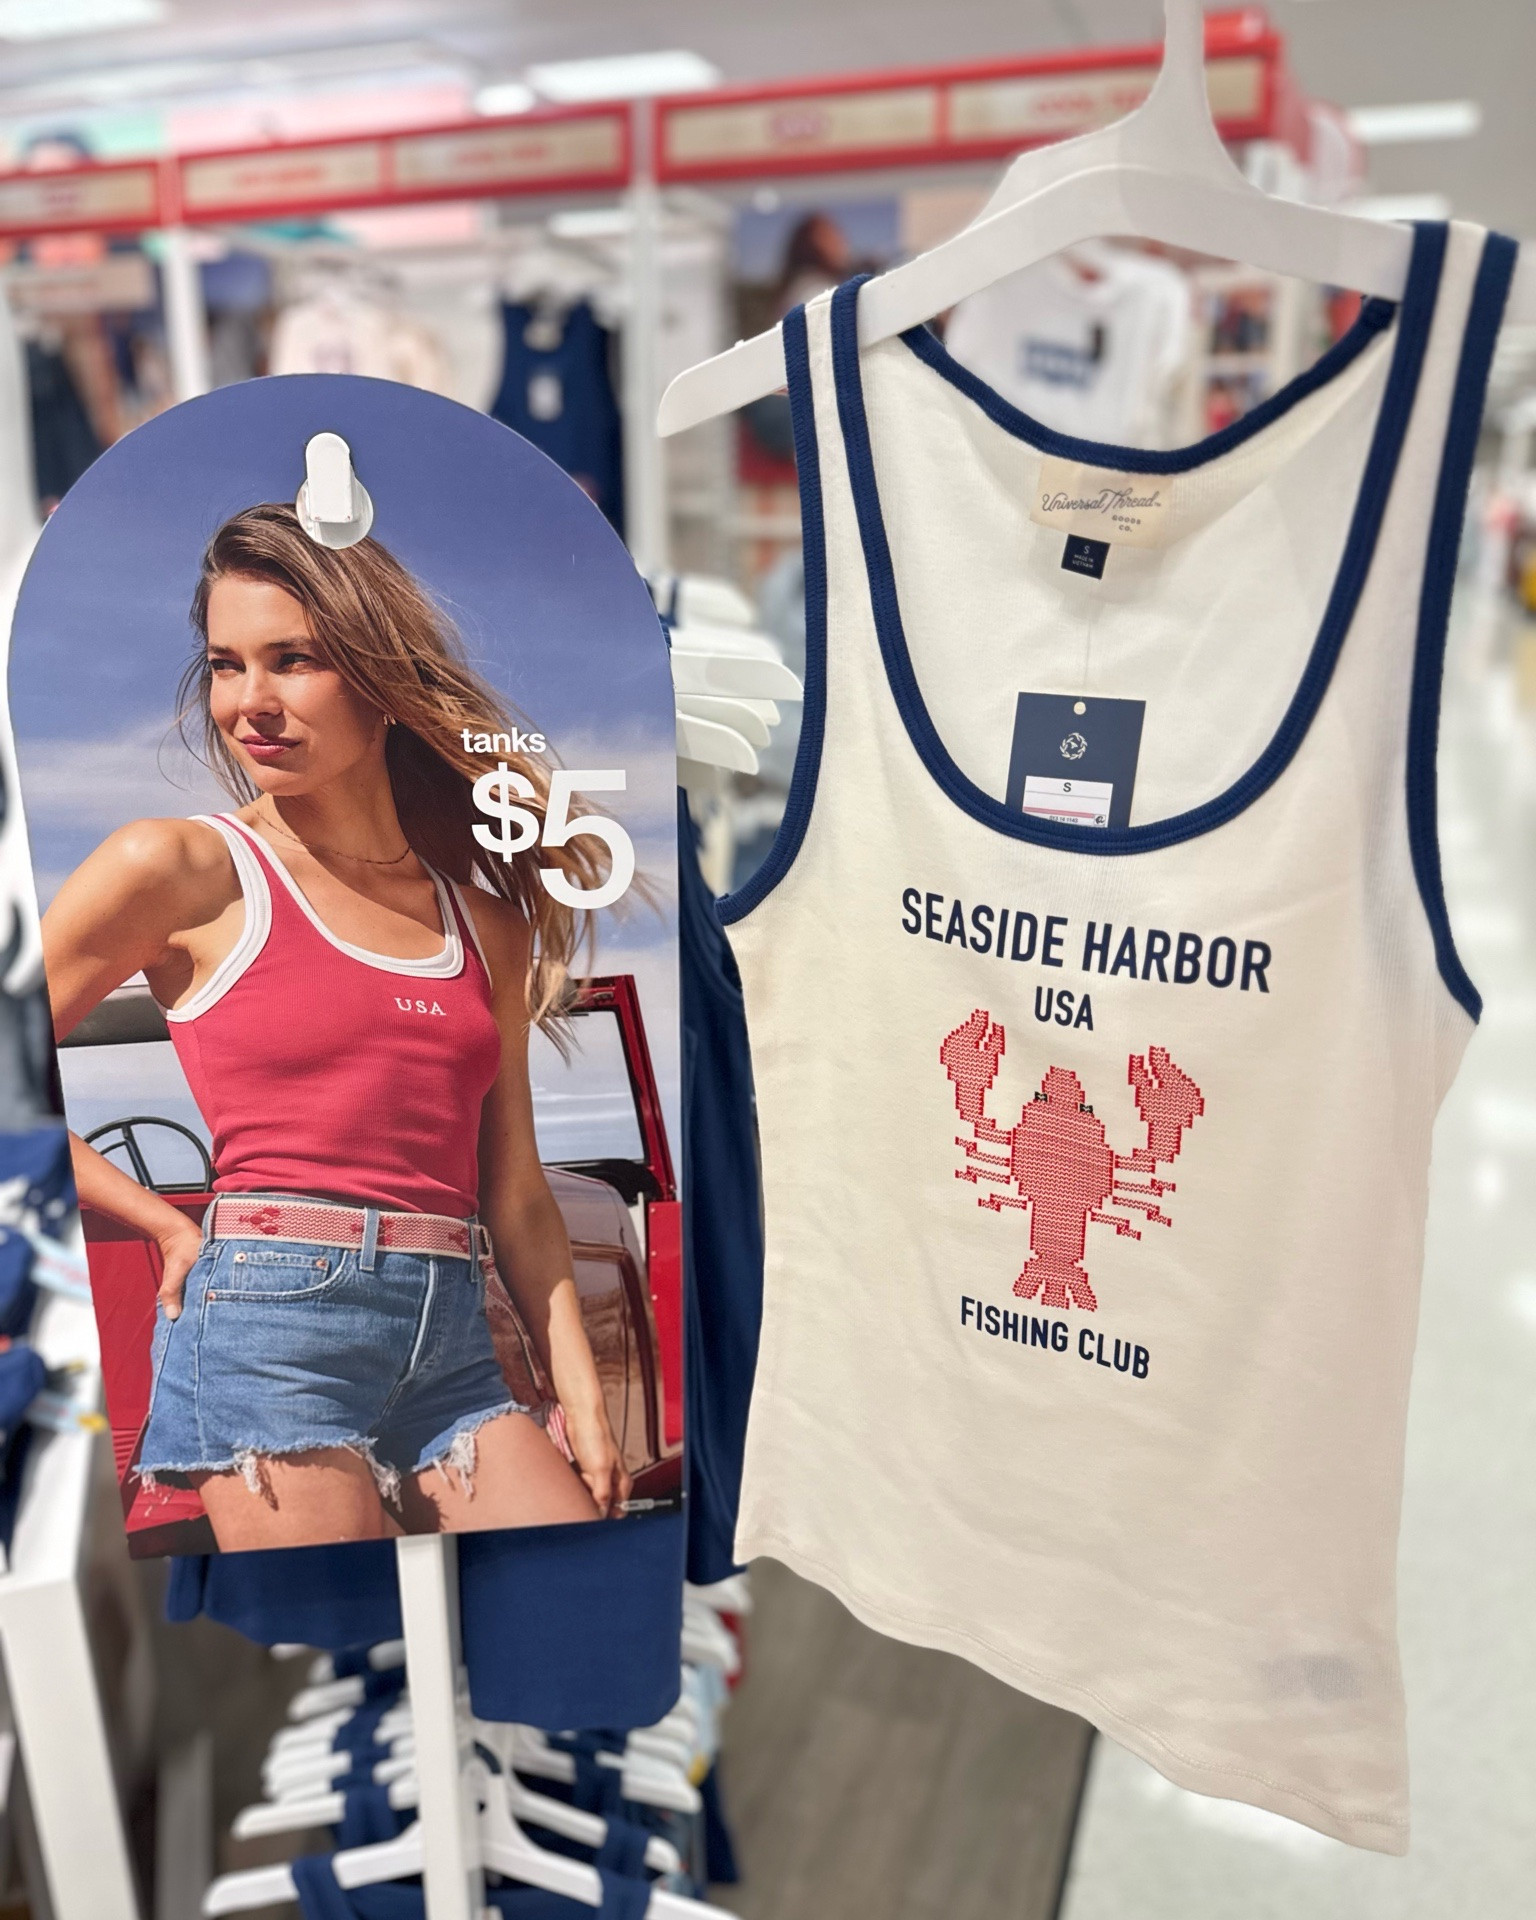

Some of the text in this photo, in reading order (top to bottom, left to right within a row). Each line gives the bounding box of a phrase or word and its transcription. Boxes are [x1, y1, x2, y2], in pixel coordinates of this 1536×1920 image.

[1042, 492, 1108, 512] Universal
[1112, 514, 1141, 525] GOODS
[1083, 545, 1090, 555] S
[460, 727, 547, 754] tanks
[1062, 782, 1072, 793] S
[471, 762, 635, 910] $5
[902, 887, 1271, 994] SEASIDE HARBOR
[394, 997, 446, 1016] USA
[1034, 986, 1094, 1031] USA
[961, 1295, 1150, 1379] FISHING CLUB
